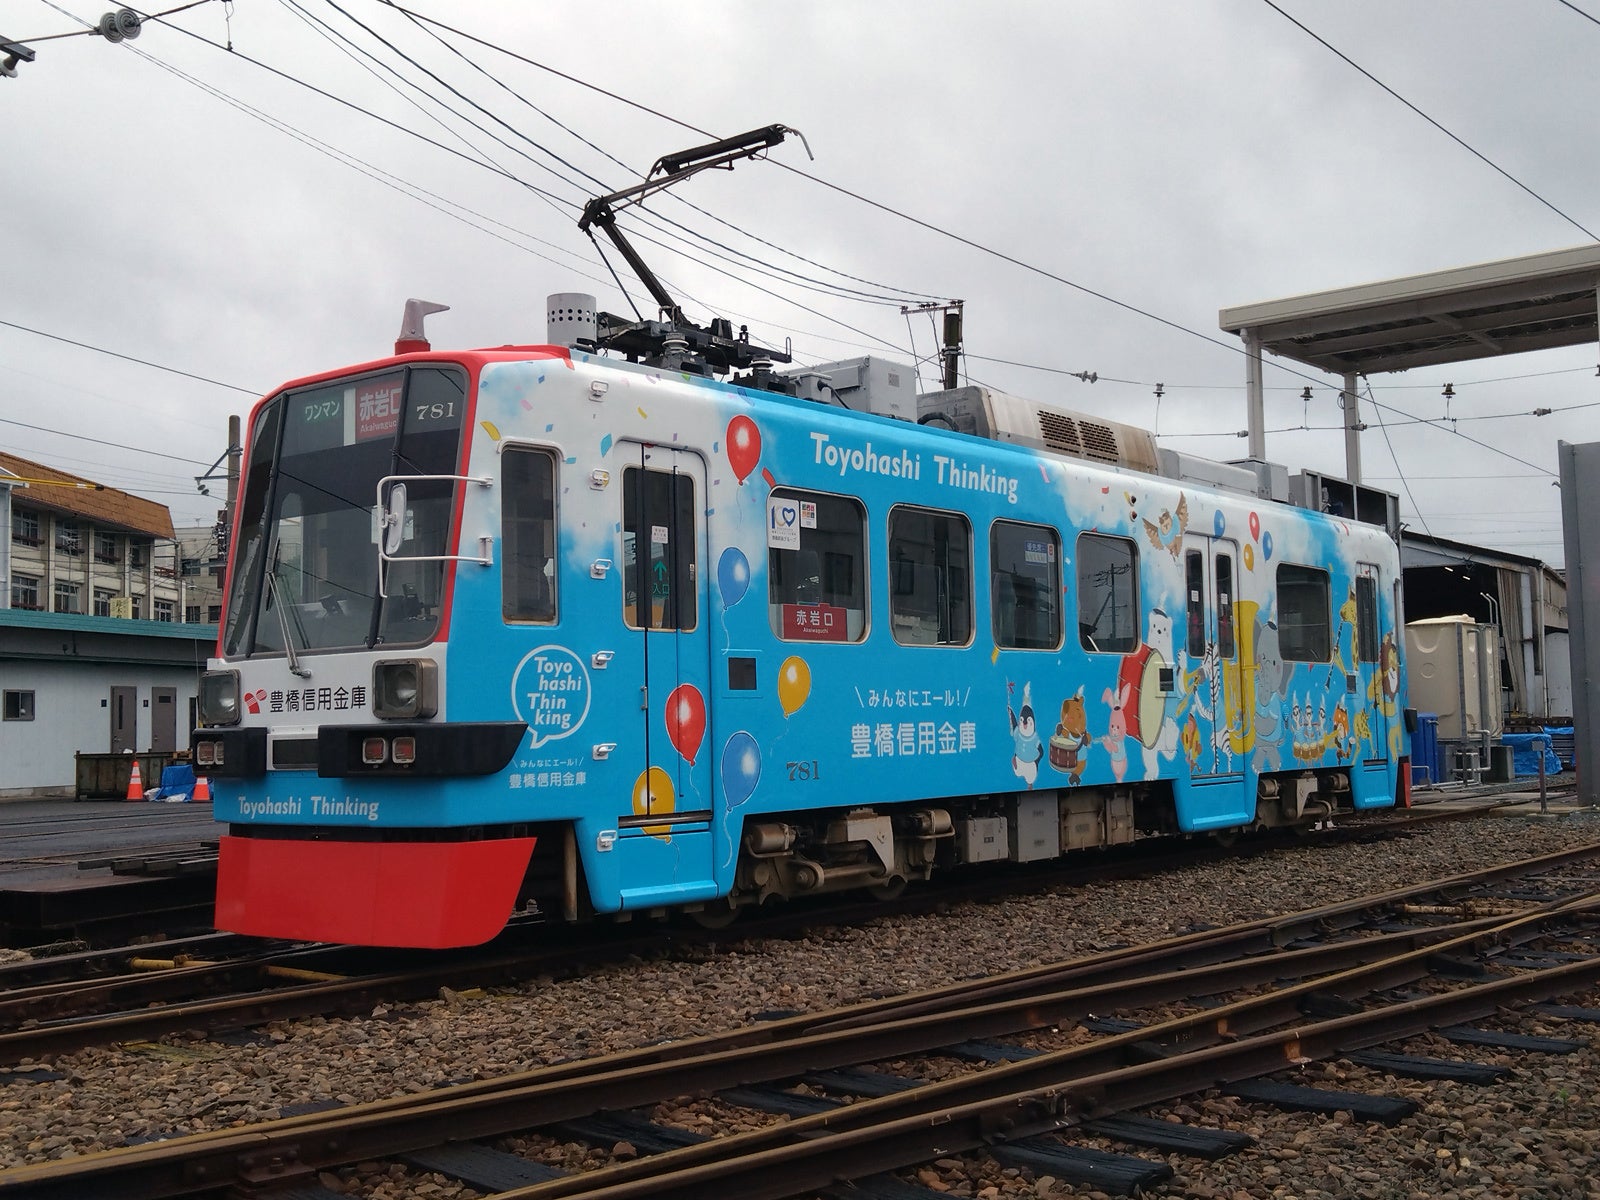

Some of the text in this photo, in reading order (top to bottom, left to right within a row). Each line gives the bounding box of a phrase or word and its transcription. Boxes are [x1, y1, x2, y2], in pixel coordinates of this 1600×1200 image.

[305, 401, 340, 421] ワンマン
[360, 388, 402, 421] 赤岩口
[416, 402, 455, 420] 781
[360, 418, 398, 433] Akaiwaguc
[810, 431, 1018, 504] Toyohashi Thinking
[653, 582, 670, 595] 入口
[796, 609, 834, 627] 赤岩口
[534, 656, 573, 677] Toyo
[539, 675, 582, 691] hashi
[269, 685, 366, 713] 豊橋信用金庫
[527, 692, 567, 709] Thin
[535, 709, 571, 729] king
[851, 720, 976, 758] 豊橋信用金庫
[509, 771, 586, 789] 豊橋信用金庫
[786, 760, 820, 781] 781
[238, 796, 379, 821] Toyohashi Thinking
